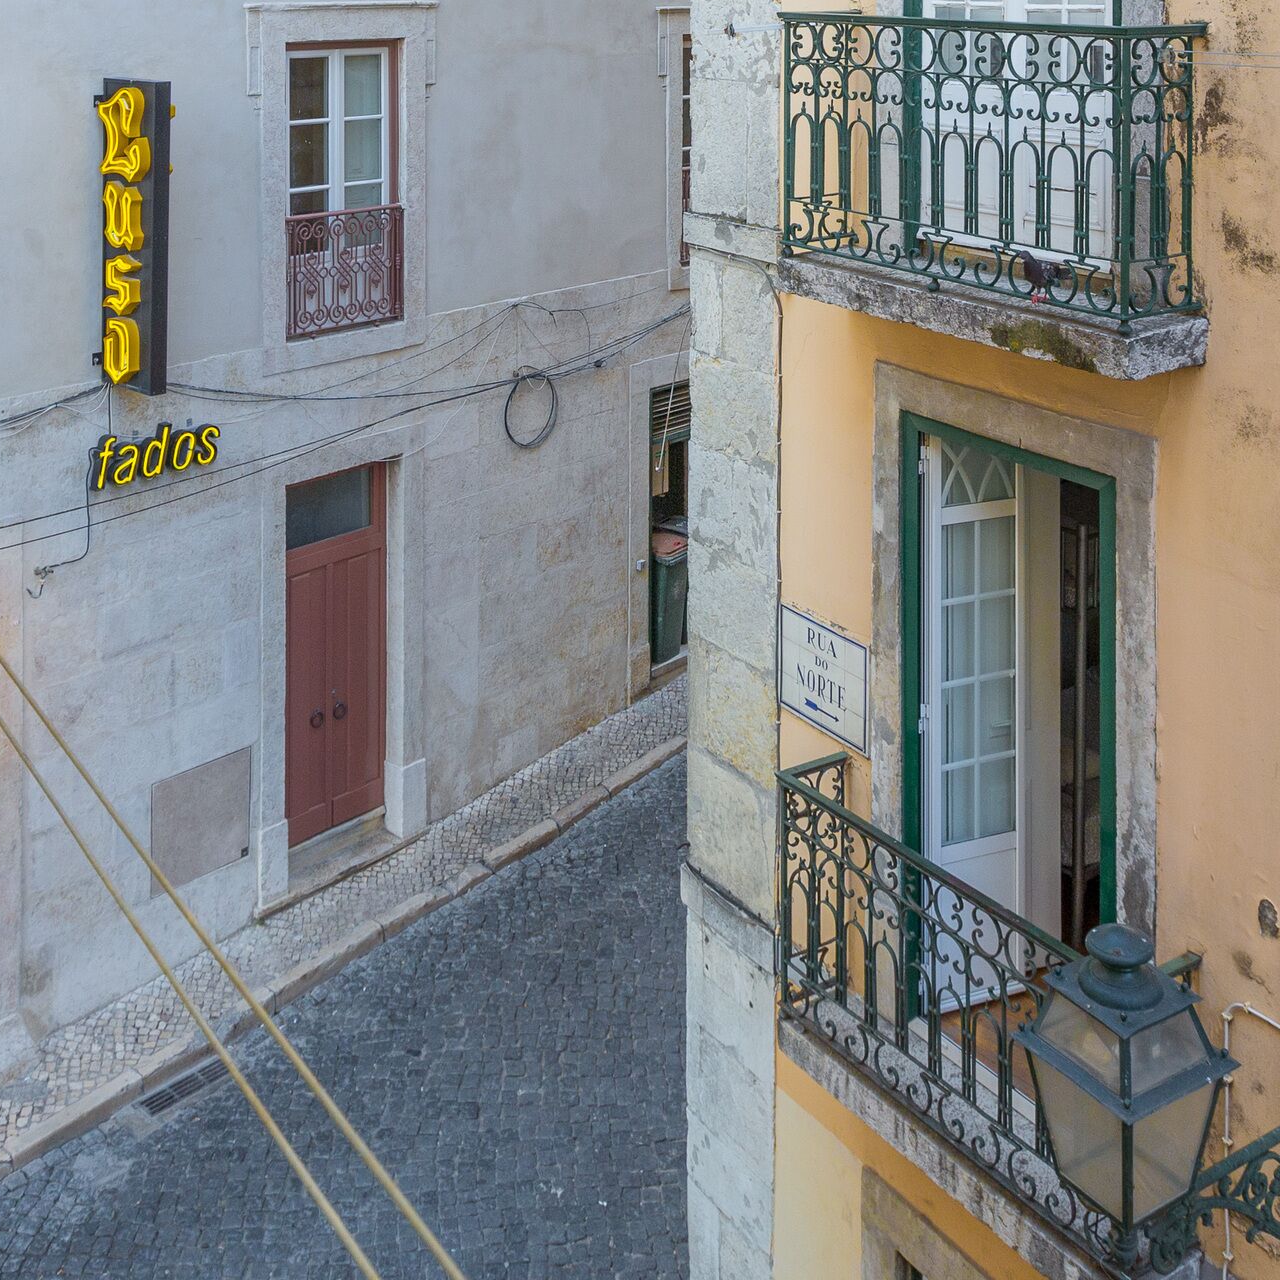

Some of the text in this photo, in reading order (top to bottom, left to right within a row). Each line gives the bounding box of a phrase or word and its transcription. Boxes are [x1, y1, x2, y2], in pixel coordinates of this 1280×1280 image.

[98, 87, 151, 384] Luso
[93, 423, 220, 490] fados
[807, 627, 837, 659] RUA
[815, 656, 829, 671] DO
[796, 662, 847, 712] NORTE
